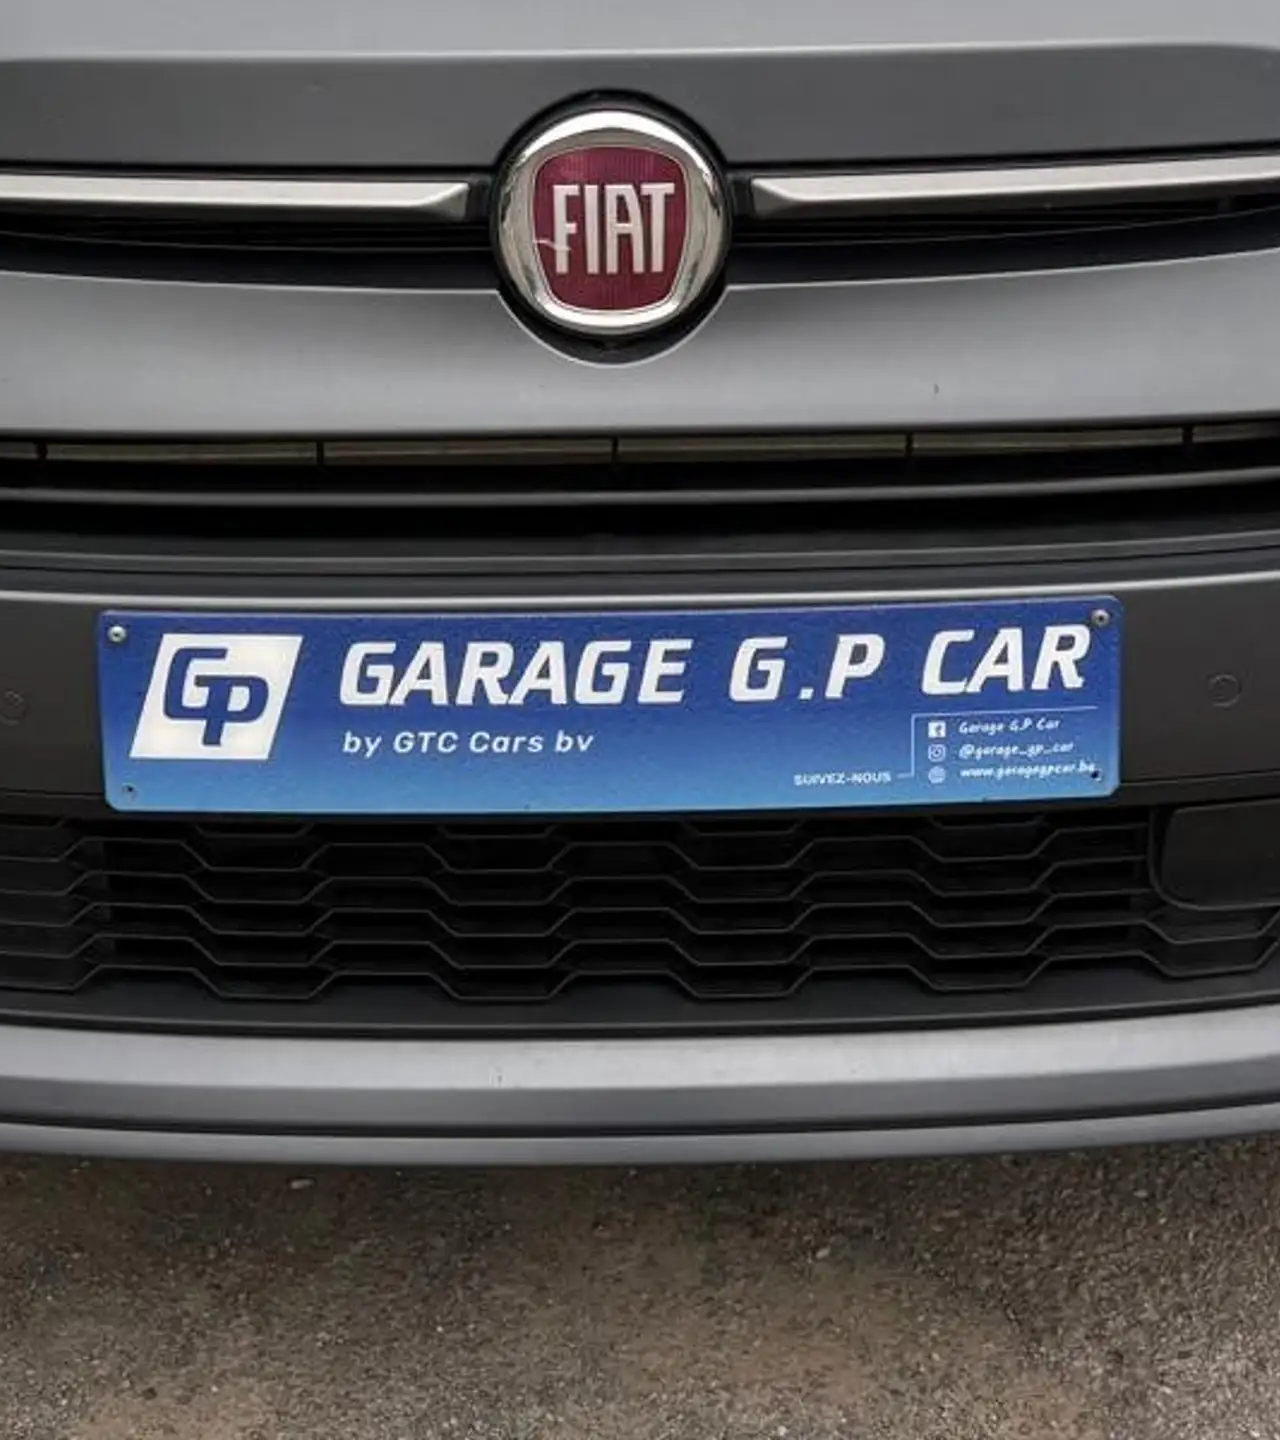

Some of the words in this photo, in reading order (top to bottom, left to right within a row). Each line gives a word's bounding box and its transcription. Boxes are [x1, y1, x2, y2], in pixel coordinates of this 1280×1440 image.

[553, 182, 675, 275] FIAT
[339, 639, 694, 705] GARAGE
[729, 633, 885, 702] G.P
[921, 625, 1091, 695] CAR
[958, 720, 1004, 738] Garage
[1036, 717, 1060, 730] Car
[342, 731, 381, 759] by
[393, 732, 458, 753] GTC
[469, 731, 544, 753] Cars
[555, 730, 595, 753] bv
[793, 771, 892, 787] SUIVEZ-NOUS
